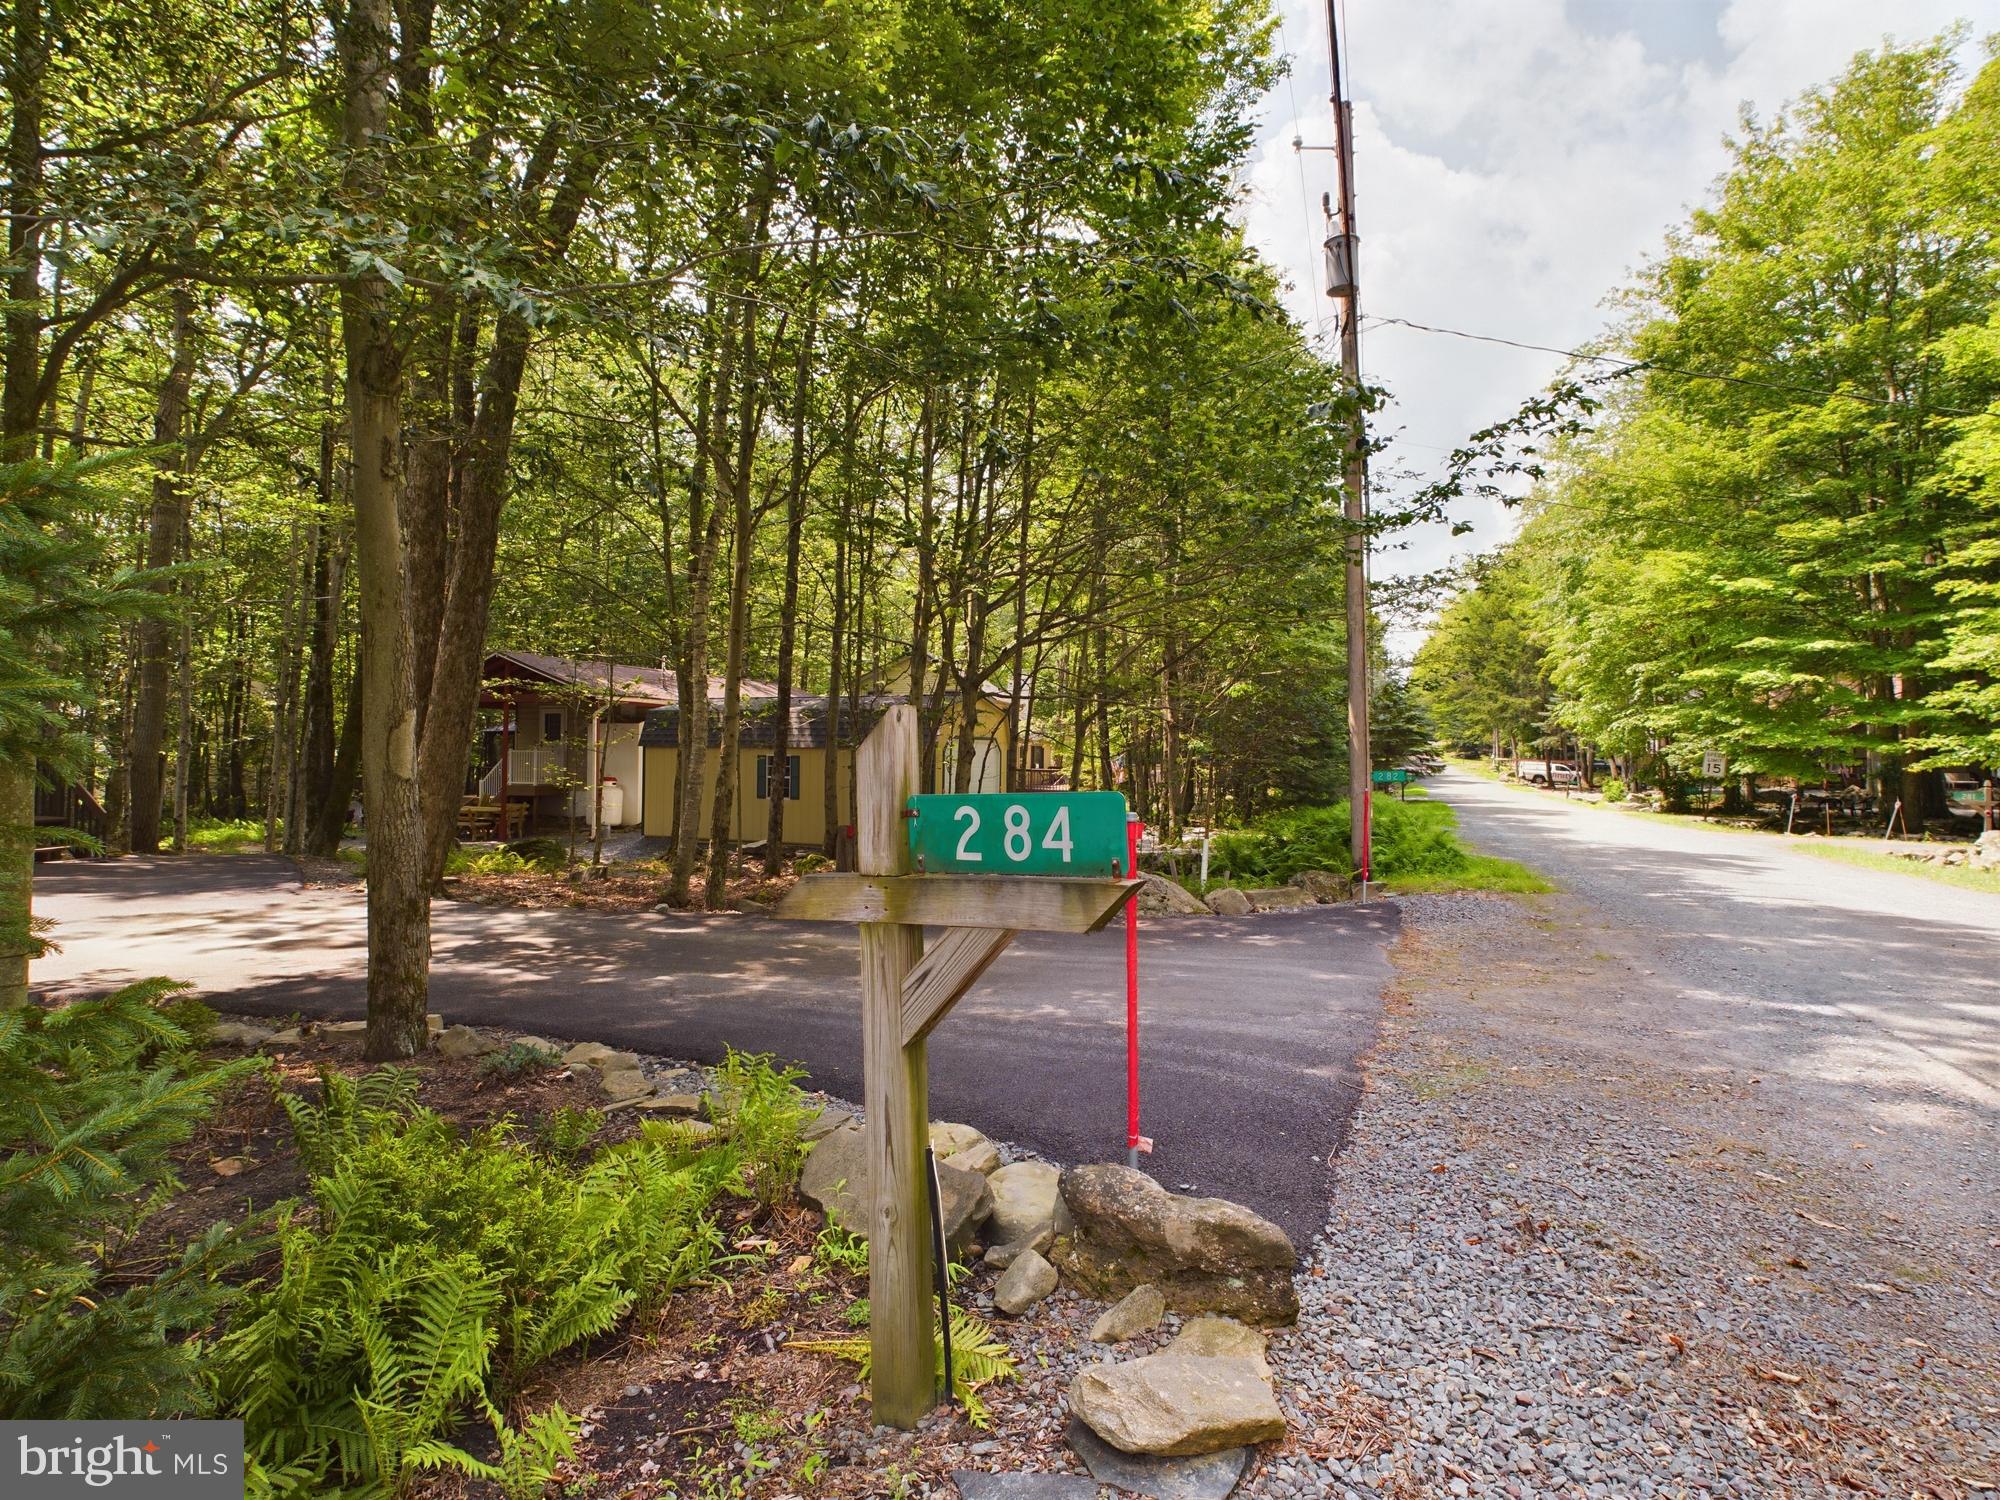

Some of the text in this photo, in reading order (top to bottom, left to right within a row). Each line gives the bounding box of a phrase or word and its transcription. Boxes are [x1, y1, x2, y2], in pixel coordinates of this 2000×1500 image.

[1707, 763, 1721, 773] 15
[1378, 772, 1399, 781] 282
[954, 804, 1074, 862] 284
